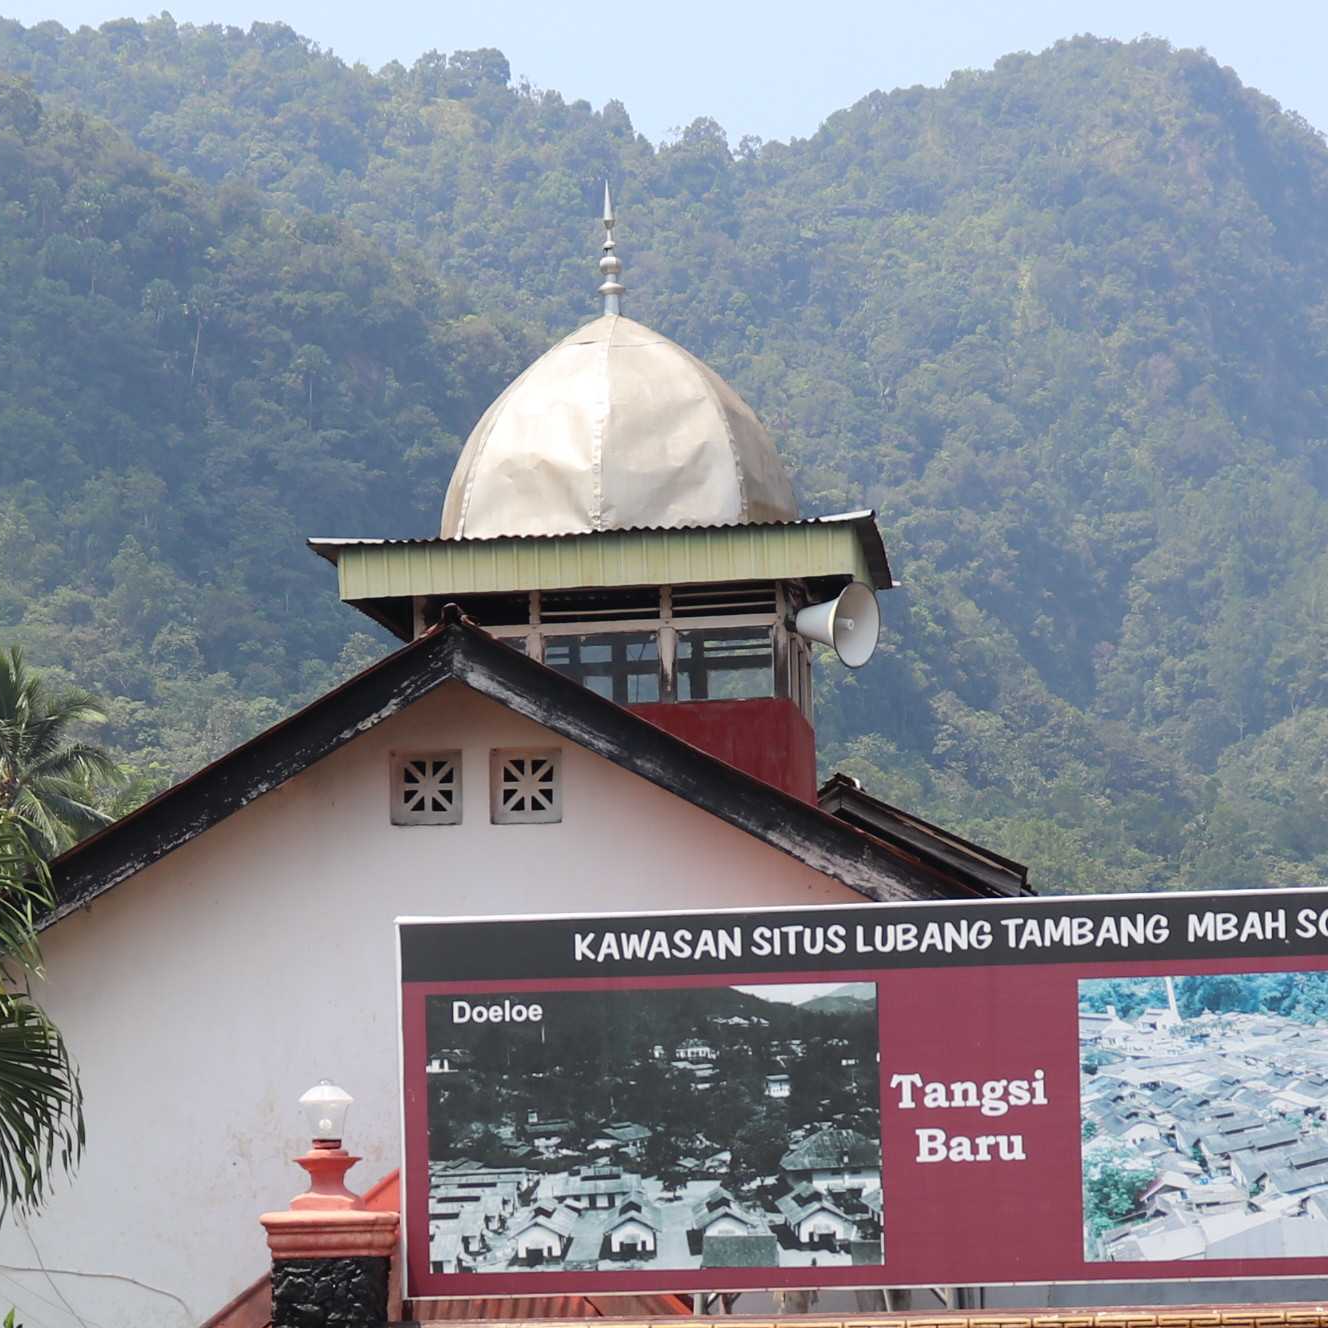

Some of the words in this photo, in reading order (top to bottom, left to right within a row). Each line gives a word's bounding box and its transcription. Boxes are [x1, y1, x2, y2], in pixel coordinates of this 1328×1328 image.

[574, 926, 742, 962] KAWASAN
[750, 924, 846, 956] SITUS
[856, 919, 993, 953] LUBANG
[1000, 913, 1170, 949] TAMBANG
[1187, 908, 1287, 943] MBAH
[452, 999, 544, 1024] Doeloe
[890, 1069, 1049, 1117] Tangsi
[915, 1128, 1027, 1163] Baru
